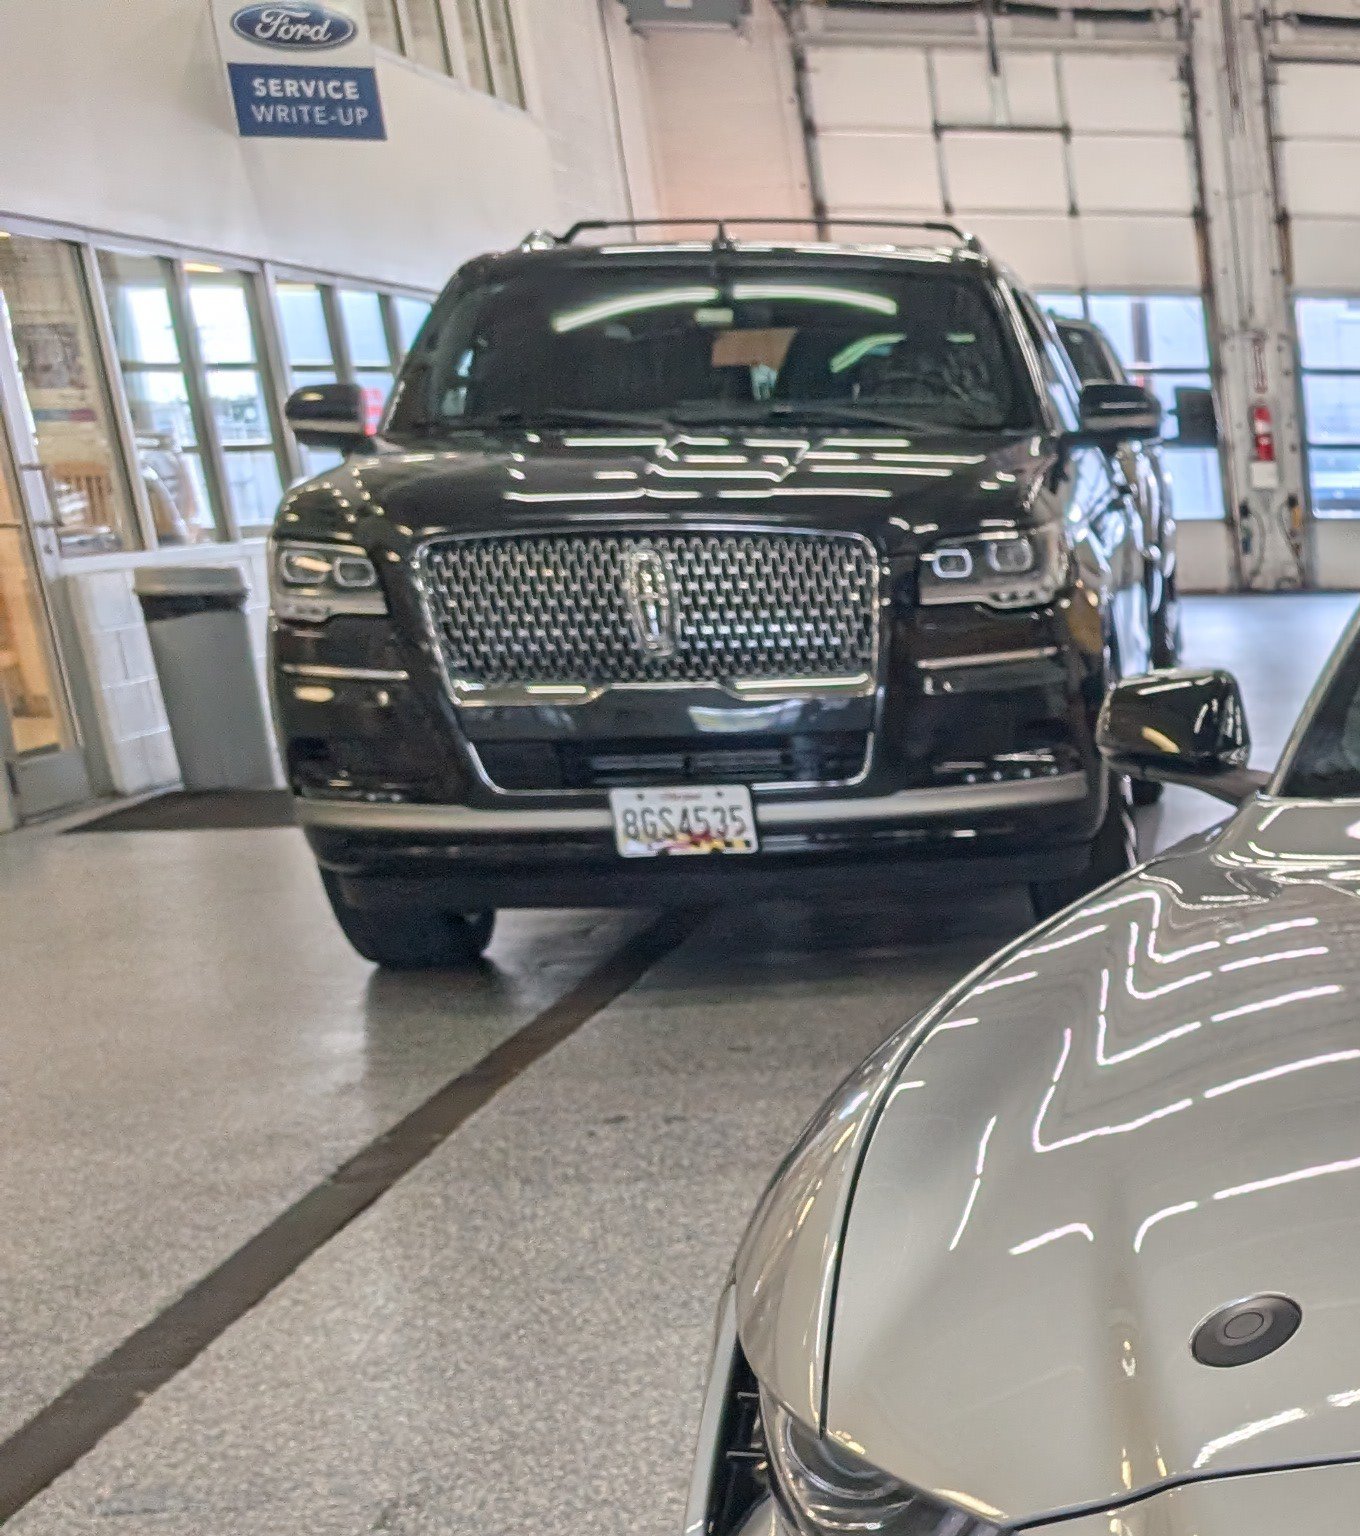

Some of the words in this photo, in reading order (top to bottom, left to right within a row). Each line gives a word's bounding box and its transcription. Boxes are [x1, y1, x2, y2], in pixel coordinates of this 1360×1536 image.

[254, 8, 333, 42] Ford
[252, 77, 360, 101] SERVICE
[251, 103, 369, 127] WRITE-UP
